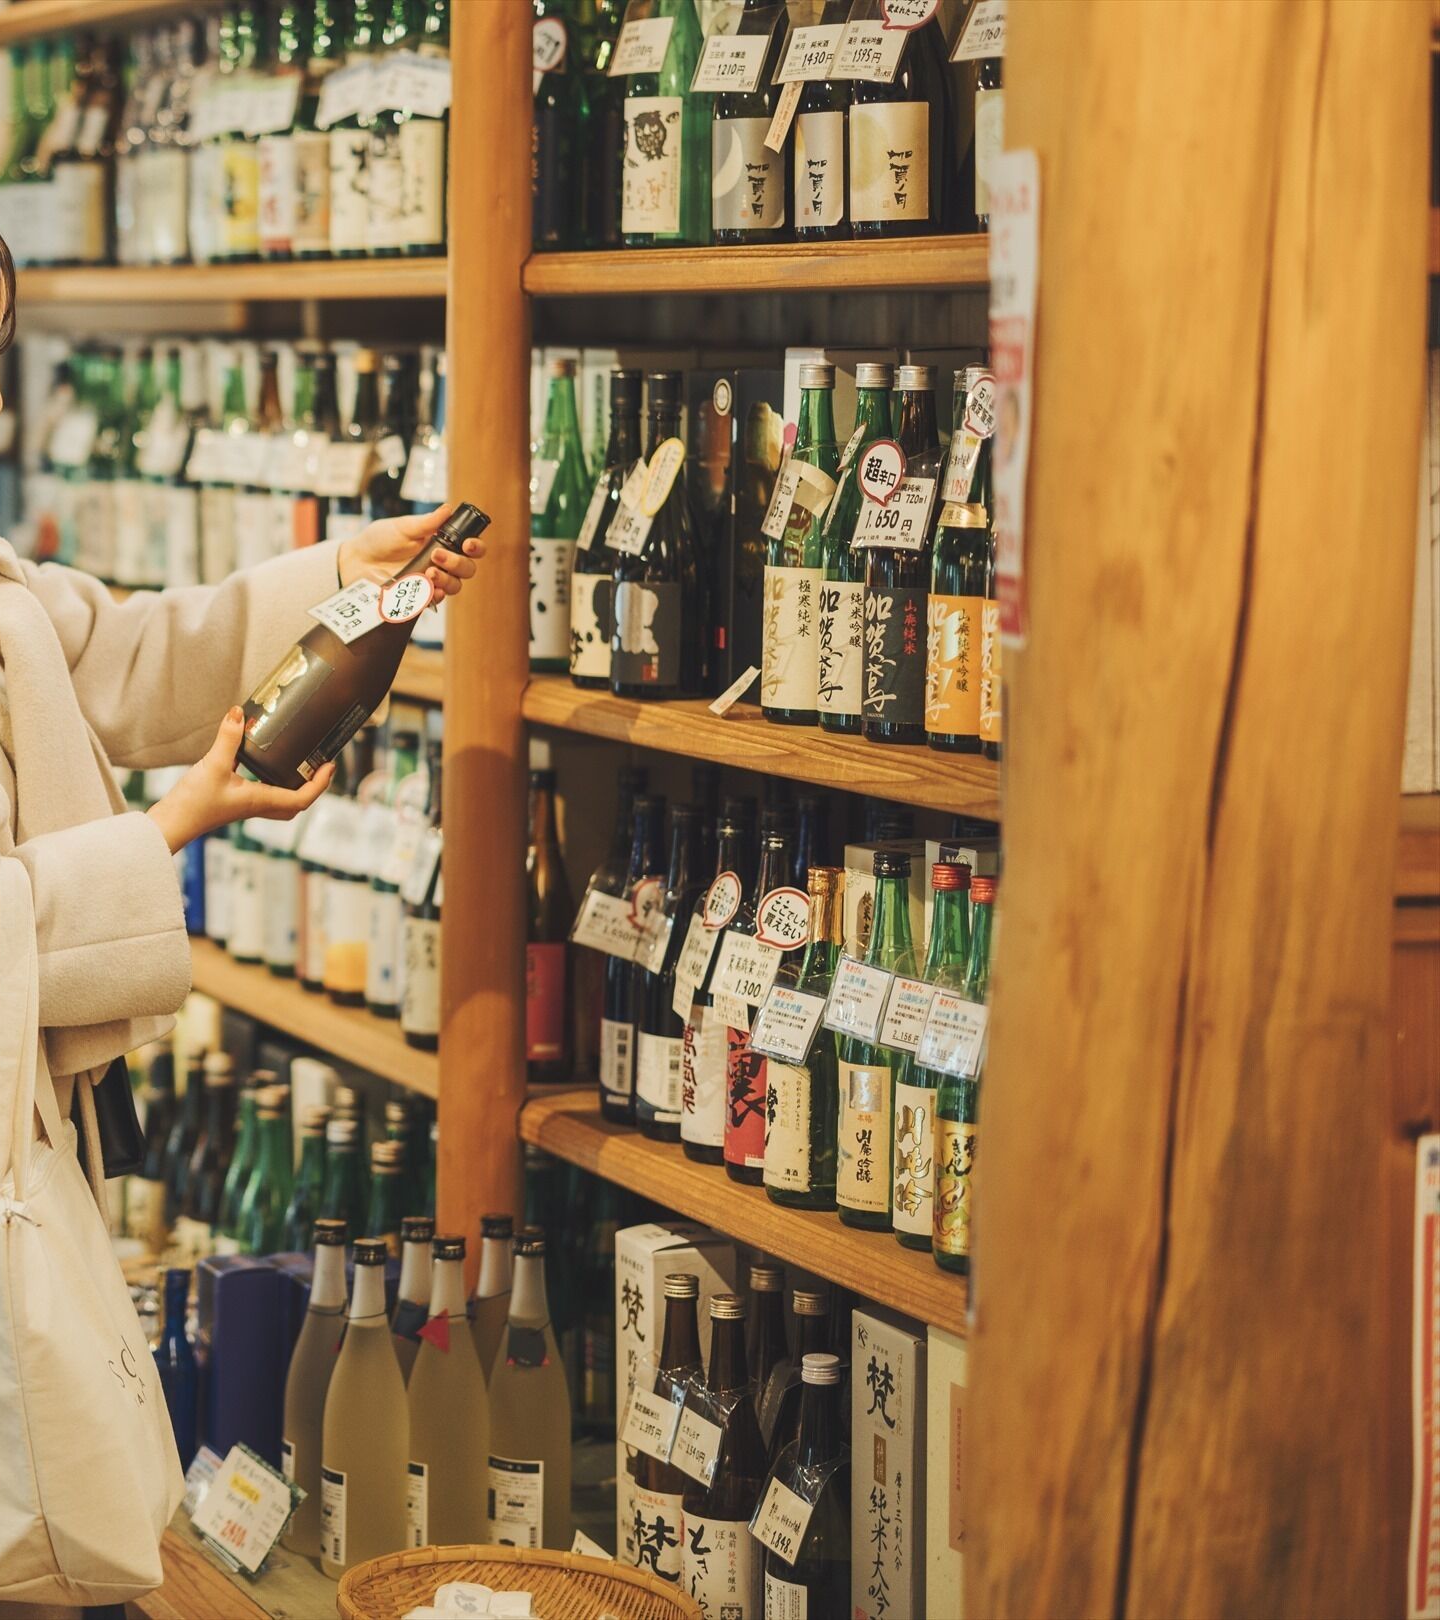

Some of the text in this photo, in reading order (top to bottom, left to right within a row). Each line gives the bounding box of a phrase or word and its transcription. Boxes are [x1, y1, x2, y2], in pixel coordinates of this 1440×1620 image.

[716, 63, 746, 77] 1210円
[852, 48, 882, 64] 1595円
[864, 455, 897, 488] 超辛口
[901, 519, 912, 531] 円
[389, 580, 410, 619] この一本
[797, 579, 811, 638] 極寒純米
[849, 592, 864, 648] 純米吟醸
[903, 599, 917, 656] 山廃純米
[955, 608, 971, 693] 山廃純米吟醸
[763, 911, 802, 940] 買えない
[770, 895, 808, 928] ここでしか
[621, 1278, 646, 1343] 梵
[866, 1355, 896, 1430] 梵
[633, 1508, 681, 1583] 梵
[868, 1485, 891, 1620] 純米大吟
